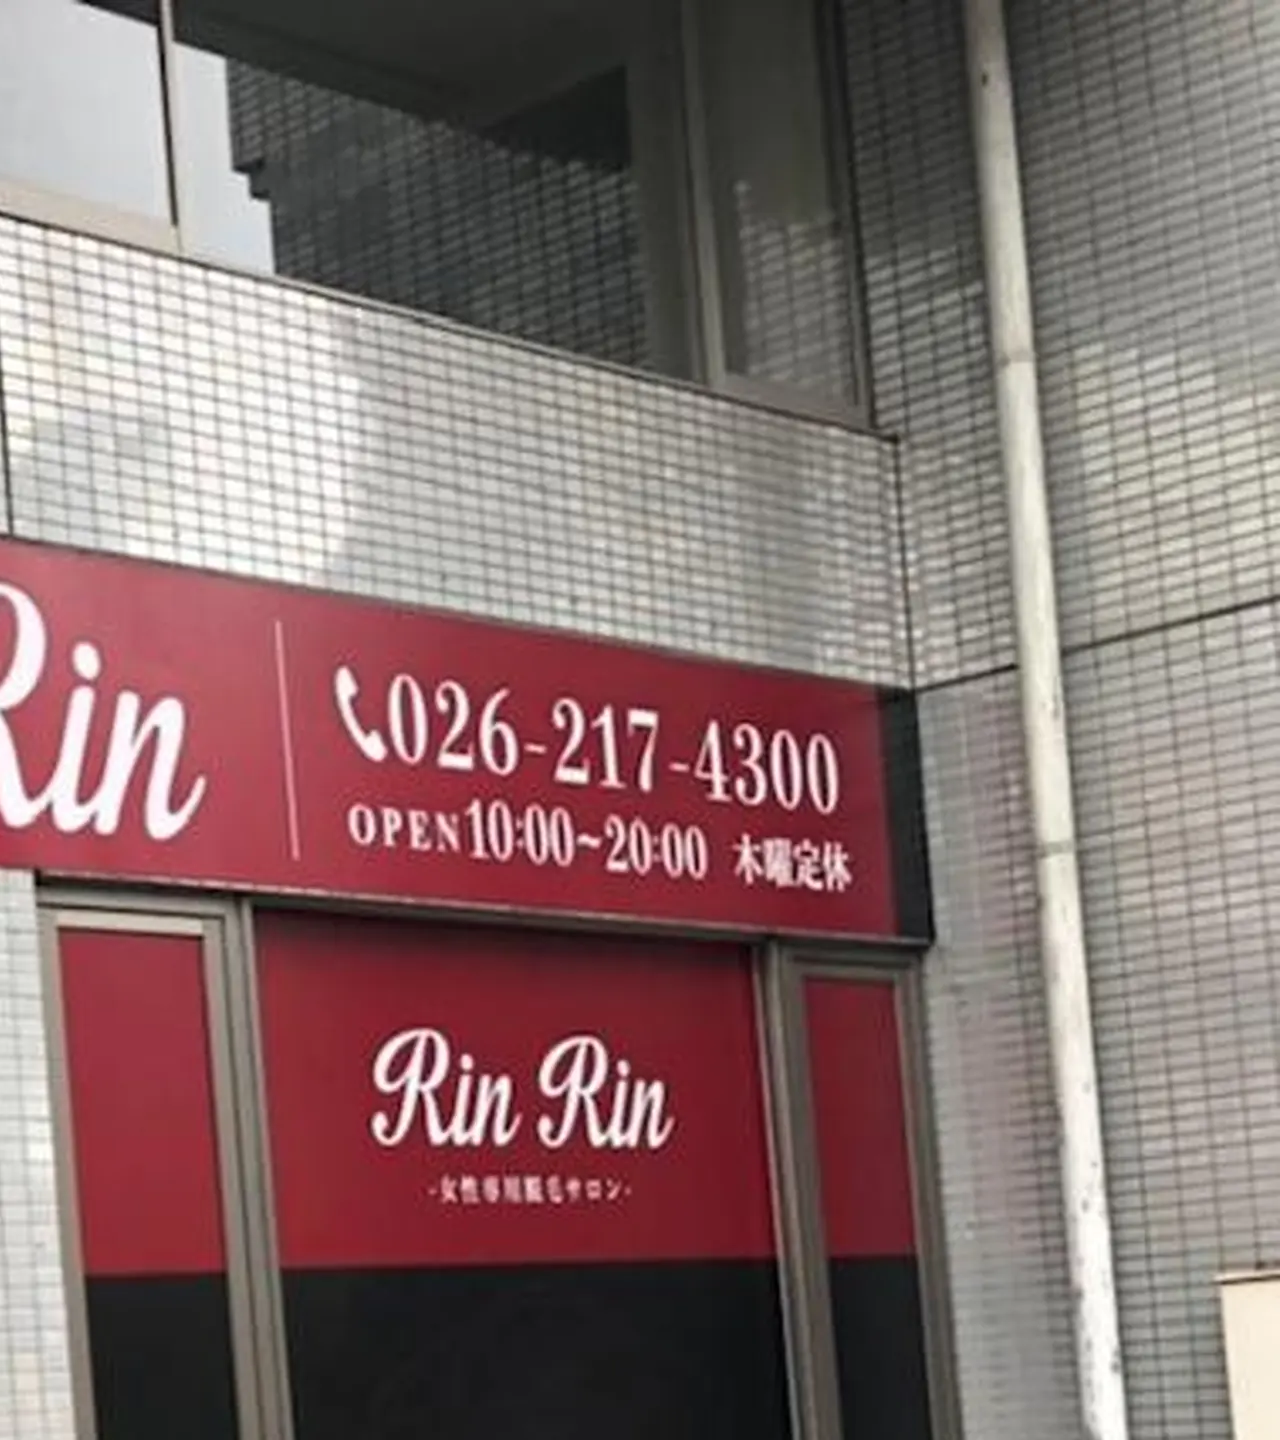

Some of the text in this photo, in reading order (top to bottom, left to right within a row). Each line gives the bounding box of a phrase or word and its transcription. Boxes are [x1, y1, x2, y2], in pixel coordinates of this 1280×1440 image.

[387, 673, 839, 815] 026-217-4300
[733, 832, 853, 893] 木曜定休
[370, 1027, 674, 1150] Rin Rin
